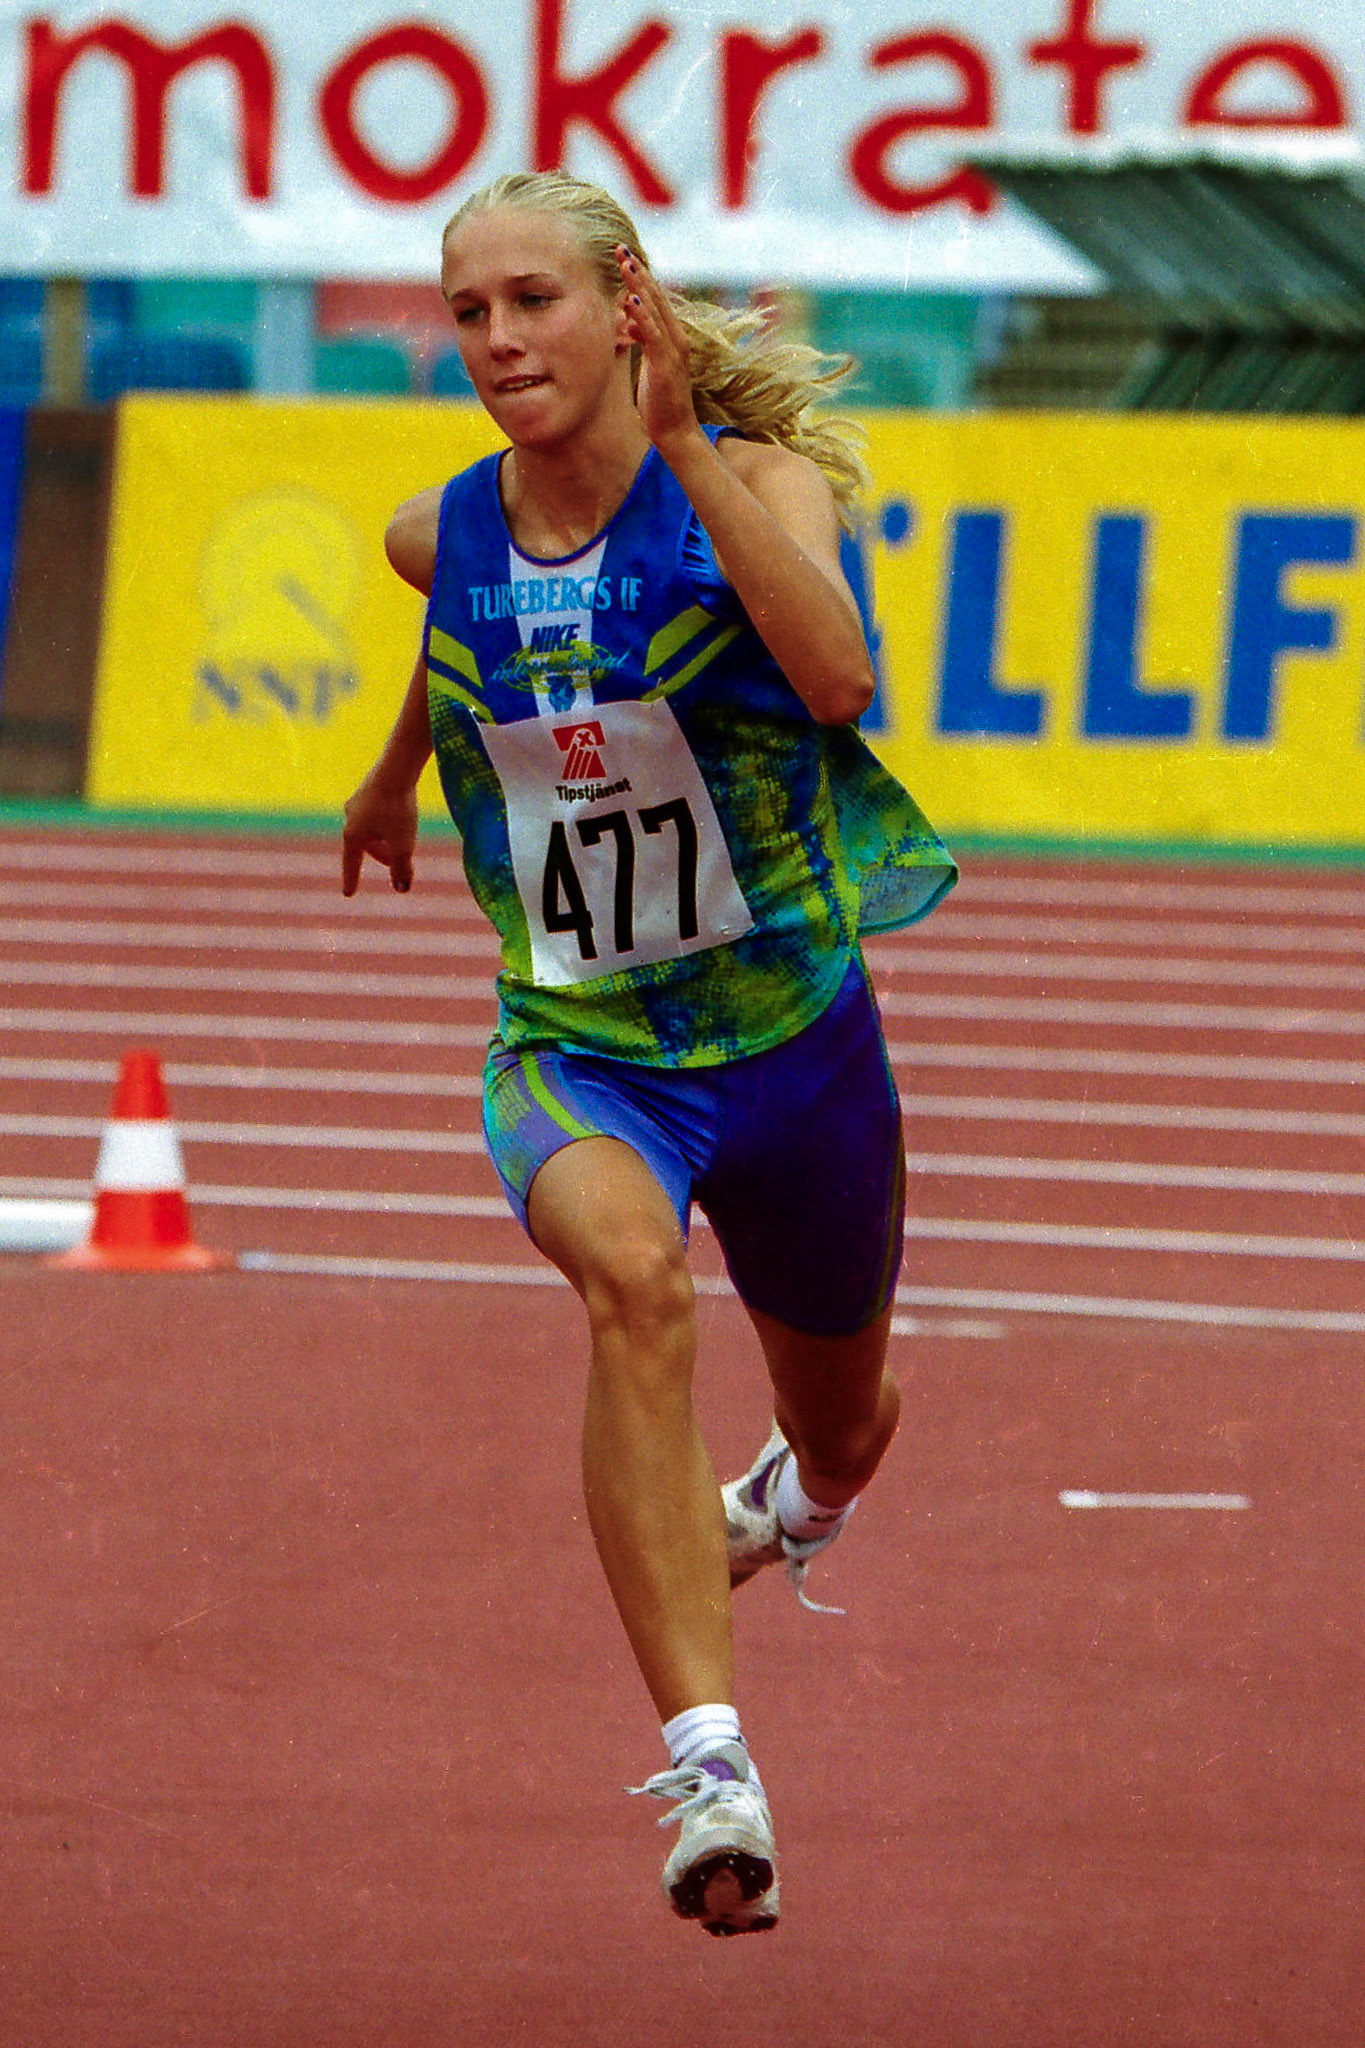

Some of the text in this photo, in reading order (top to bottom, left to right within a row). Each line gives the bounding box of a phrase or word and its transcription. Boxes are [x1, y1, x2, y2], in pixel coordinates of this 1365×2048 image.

[468, 576, 643, 622] TUREBERGS IF
[838, 502, 1365, 742] LLF
[530, 623, 581, 654] NIKE
[554, 777, 633, 804] Tipstjänst
[542, 797, 699, 961] 477
